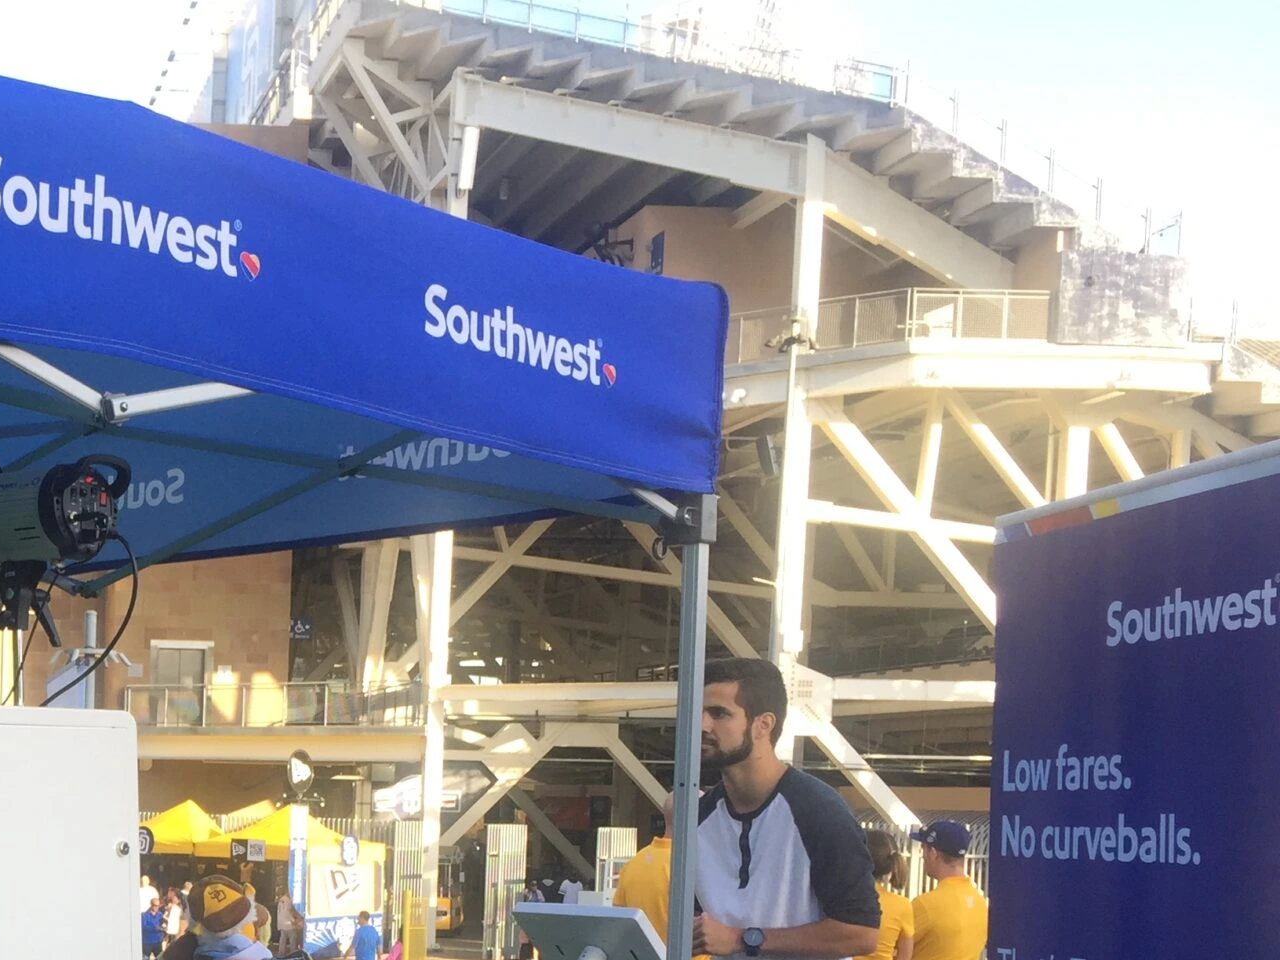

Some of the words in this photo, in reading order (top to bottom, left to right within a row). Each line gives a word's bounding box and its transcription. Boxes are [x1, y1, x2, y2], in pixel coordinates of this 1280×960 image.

[425, 283, 601, 385] Southwest
[1106, 578, 1278, 647] Southwest
[1002, 750, 1051, 792] Low
[1056, 743, 1132, 791] fares.
[1001, 815, 1036, 858] No
[1041, 813, 1201, 865] curveballs.
